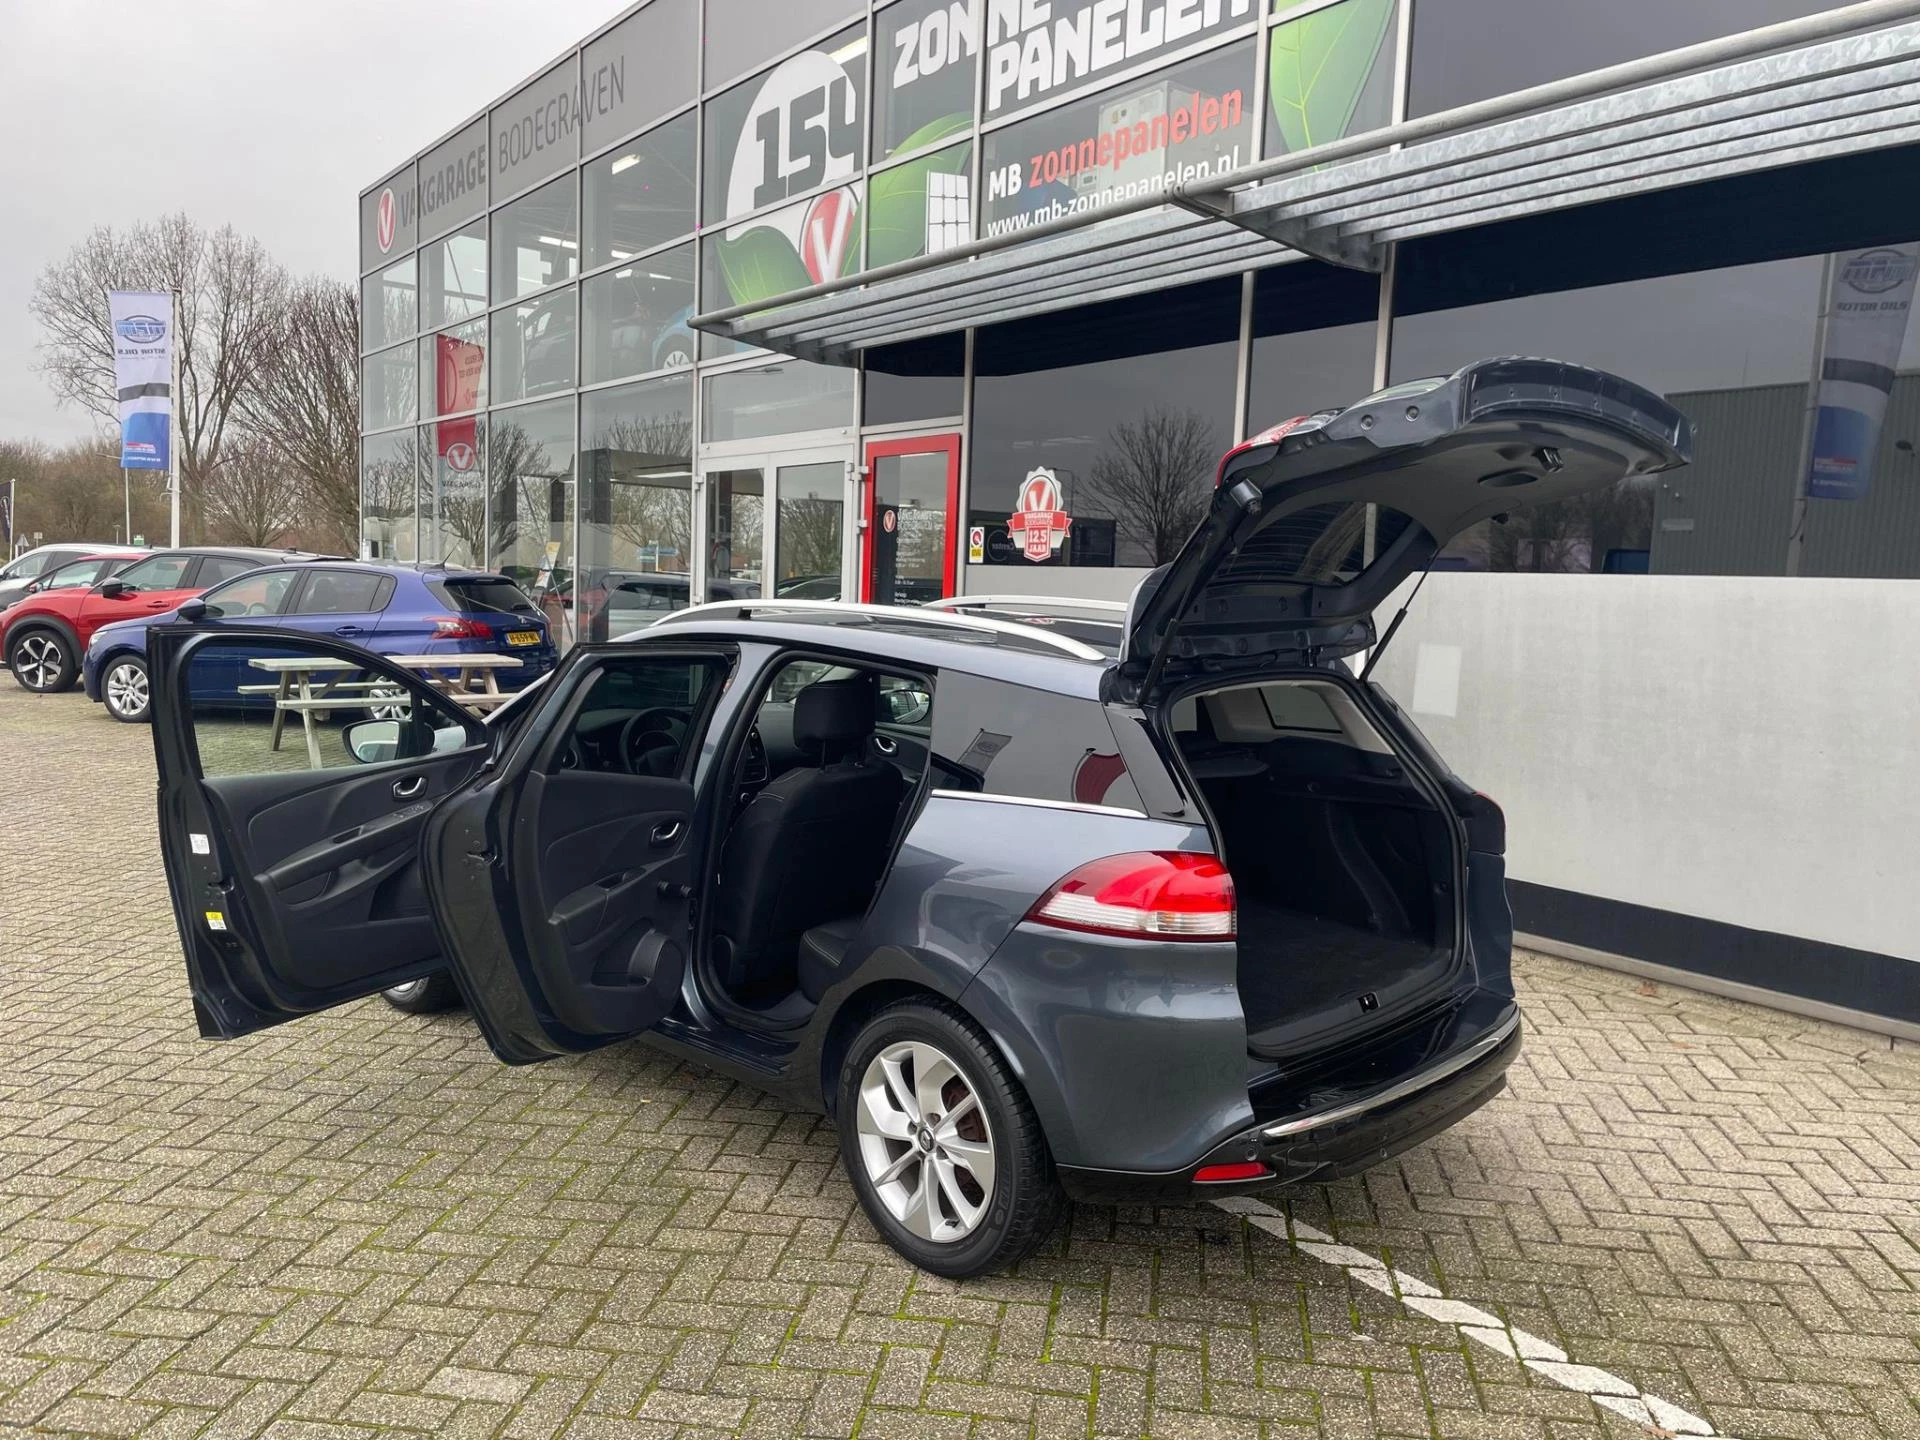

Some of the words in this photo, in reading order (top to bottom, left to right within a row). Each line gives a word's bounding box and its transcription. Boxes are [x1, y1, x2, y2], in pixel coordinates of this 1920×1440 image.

[401, 143, 486, 228] VAKGARAGE
[499, 54, 625, 175] BODEGRAVEN
[987, 144, 1240, 239] www.mb-zonnepanelen.nl
[988, 162, 1023, 202] MB
[1028, 88, 1244, 189] zonnepanelen
